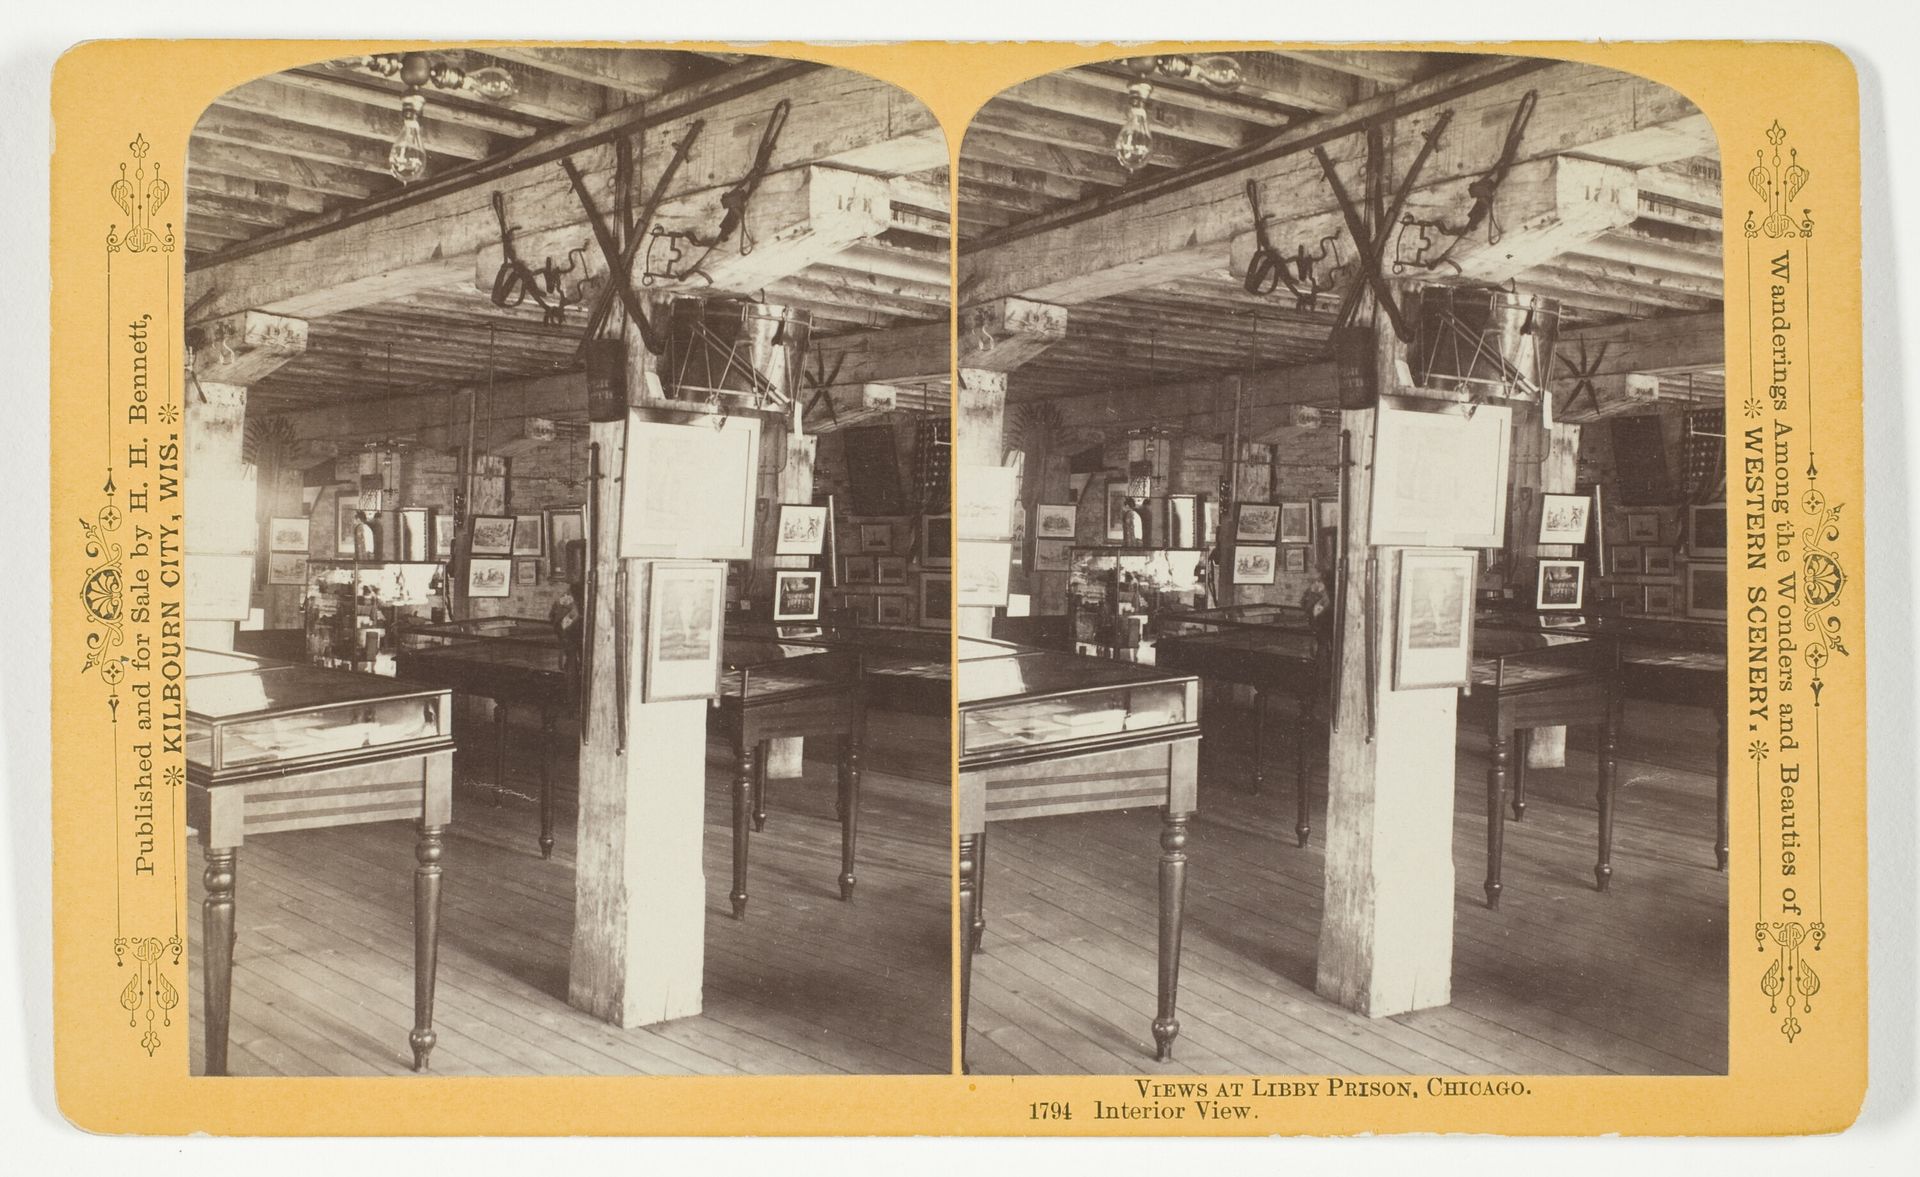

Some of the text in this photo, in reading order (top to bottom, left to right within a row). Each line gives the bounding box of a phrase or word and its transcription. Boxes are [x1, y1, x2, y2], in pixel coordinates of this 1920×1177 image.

[129, 313, 154, 876] Published and for Sale by H. H. Bennett,
[159, 433, 183, 754] KILBOURN CITY, WIS.
[1745, 426, 1769, 732] WESTERN SCENERY.
[1769, 250, 1802, 916] Wanderings Among the Wonders and Beauties of
[1029, 1100, 1259, 1121] 1794 Interior View.
